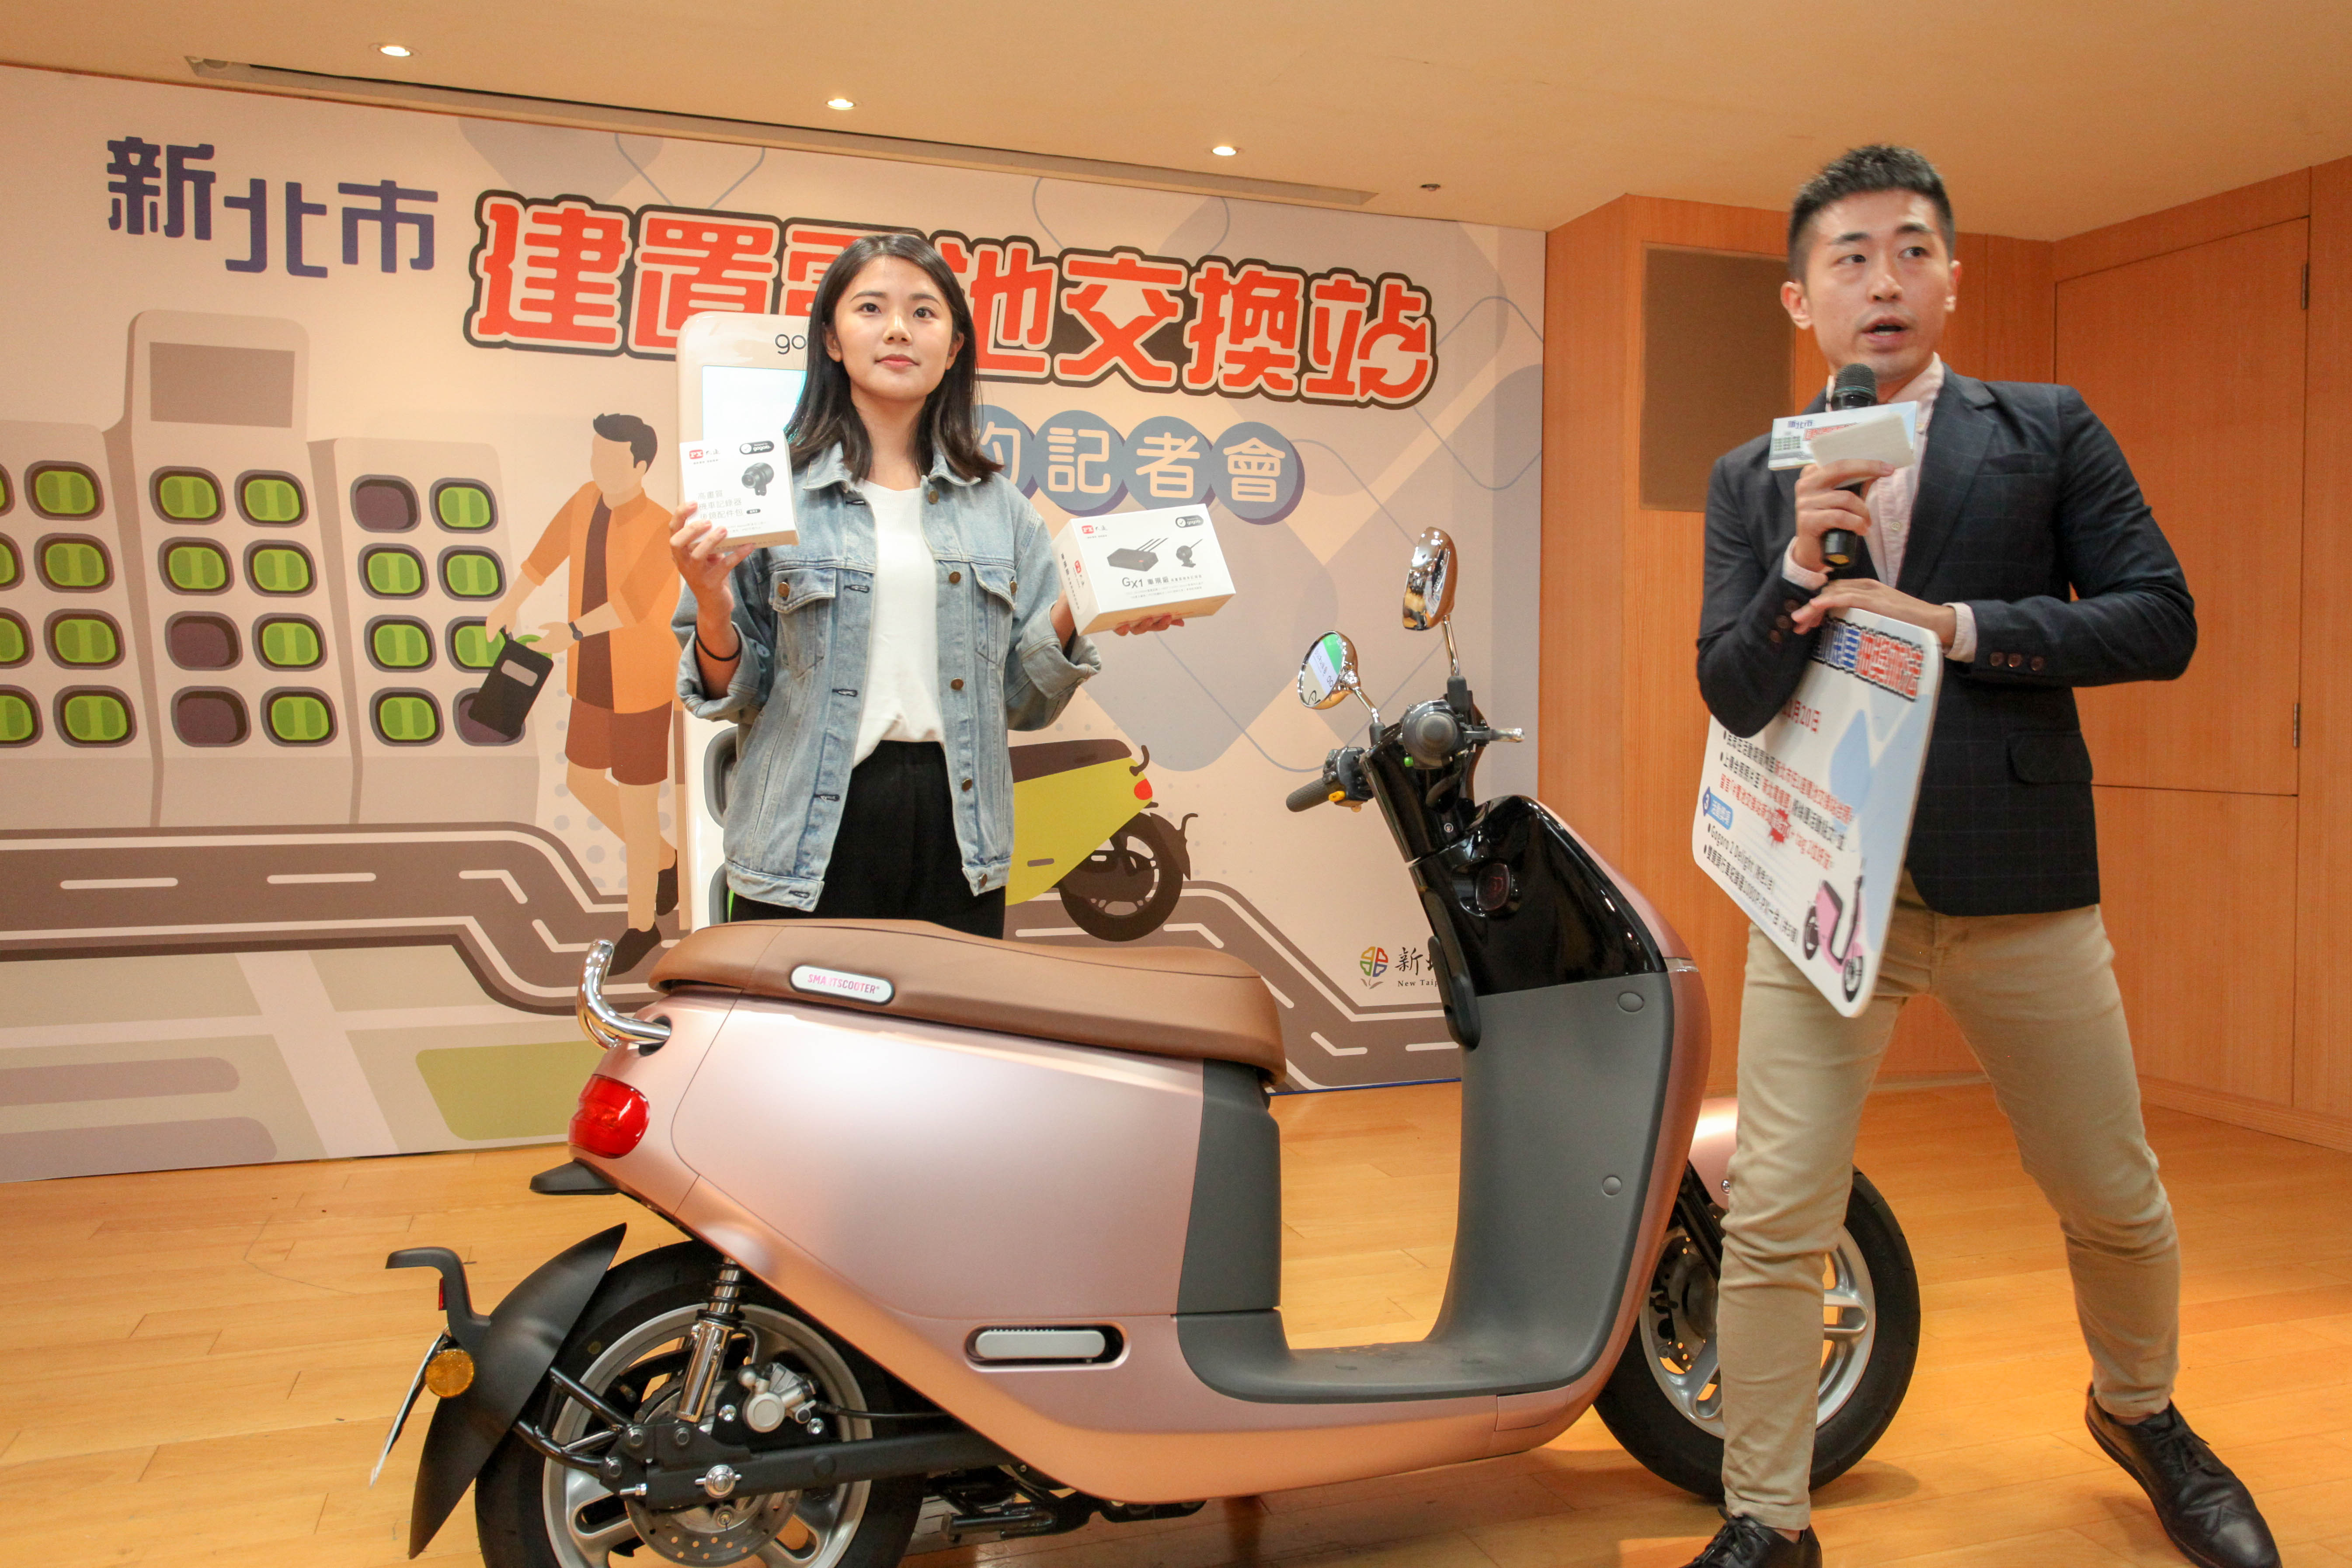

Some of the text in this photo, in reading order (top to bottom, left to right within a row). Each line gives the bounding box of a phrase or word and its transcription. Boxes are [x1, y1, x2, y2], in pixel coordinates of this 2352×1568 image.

[107, 136, 438, 278] 新北市
[1704, 793, 1710, 810] 3
